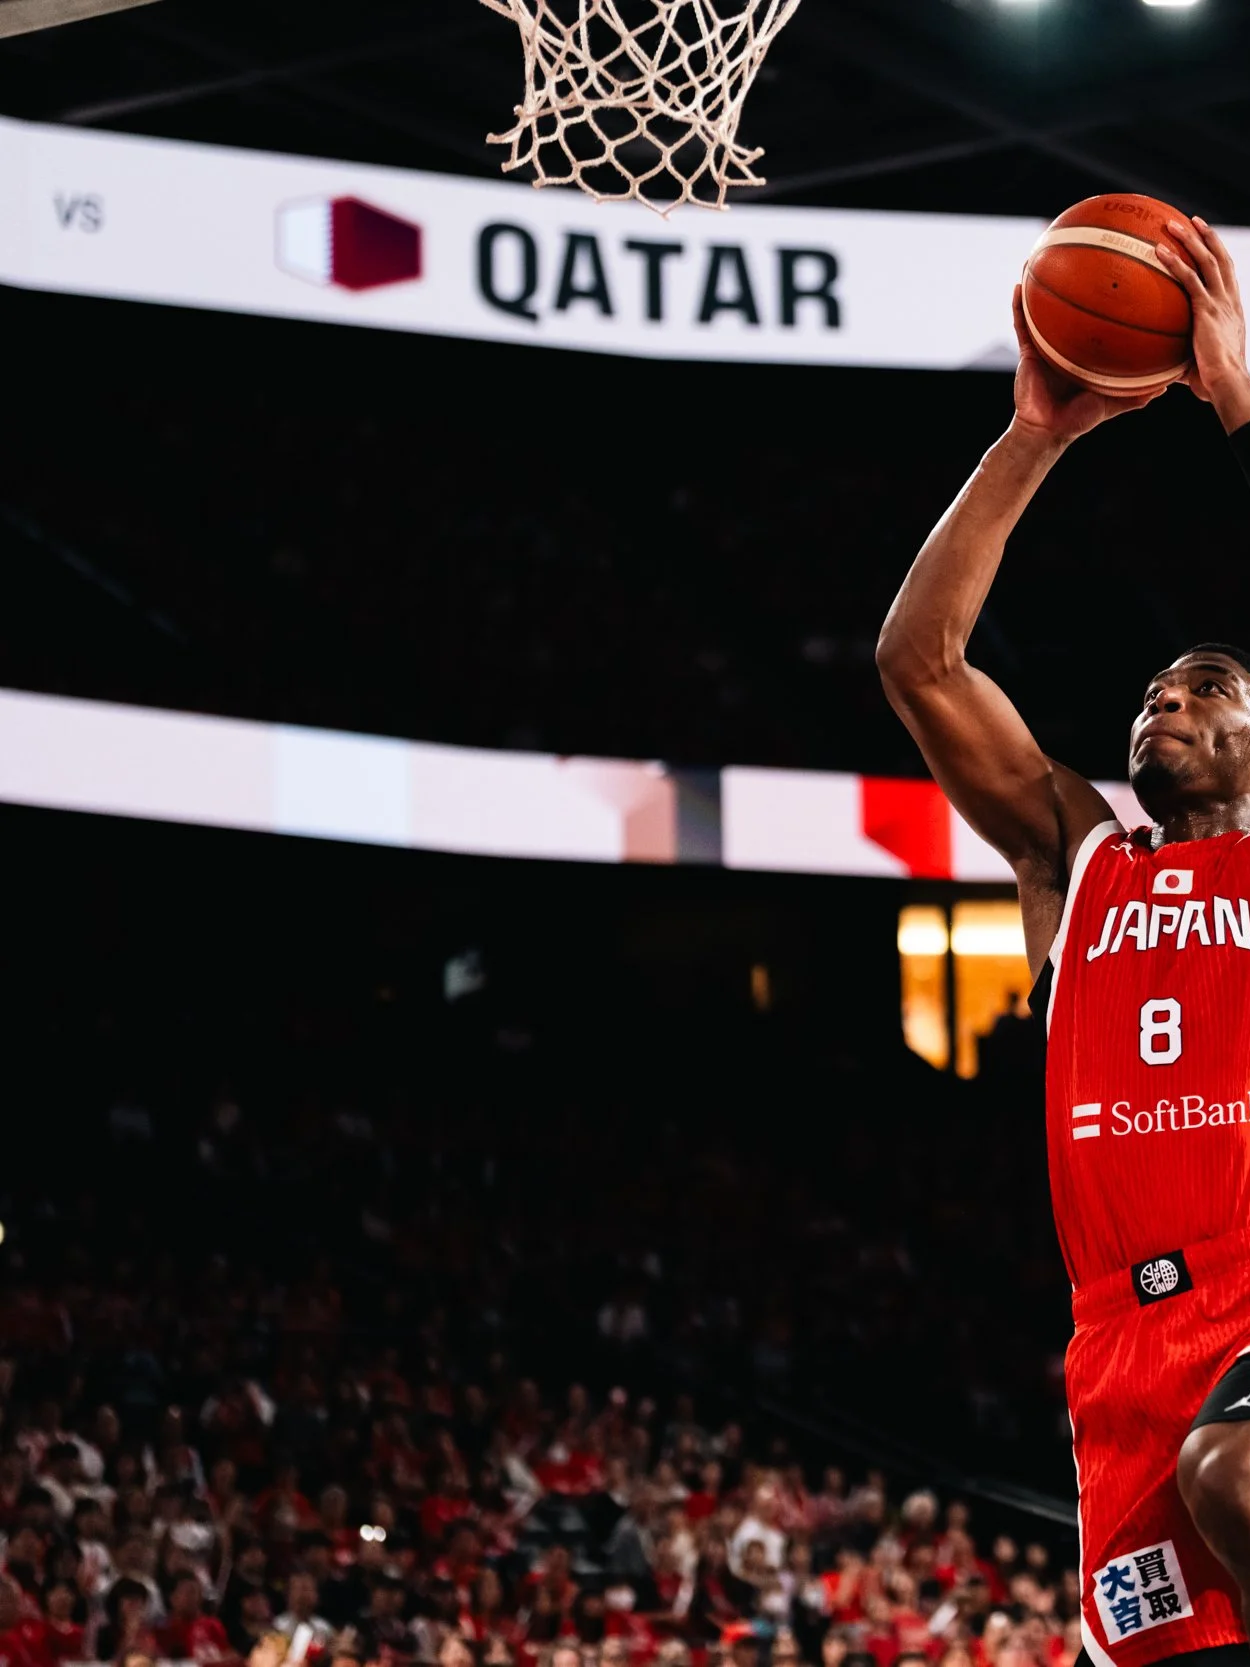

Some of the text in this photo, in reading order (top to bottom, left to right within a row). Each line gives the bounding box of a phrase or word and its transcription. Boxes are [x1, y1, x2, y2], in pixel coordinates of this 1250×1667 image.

[476, 221, 842, 328] QATAR
[1100, 232, 1157, 261] UALIFIERS
[1138, 997, 1182, 1065] 8
[1153, 1261, 1166, 1293] JPN
[1100, 1565, 1143, 1636] 大吉
[1132, 1548, 1181, 1621] 買取
